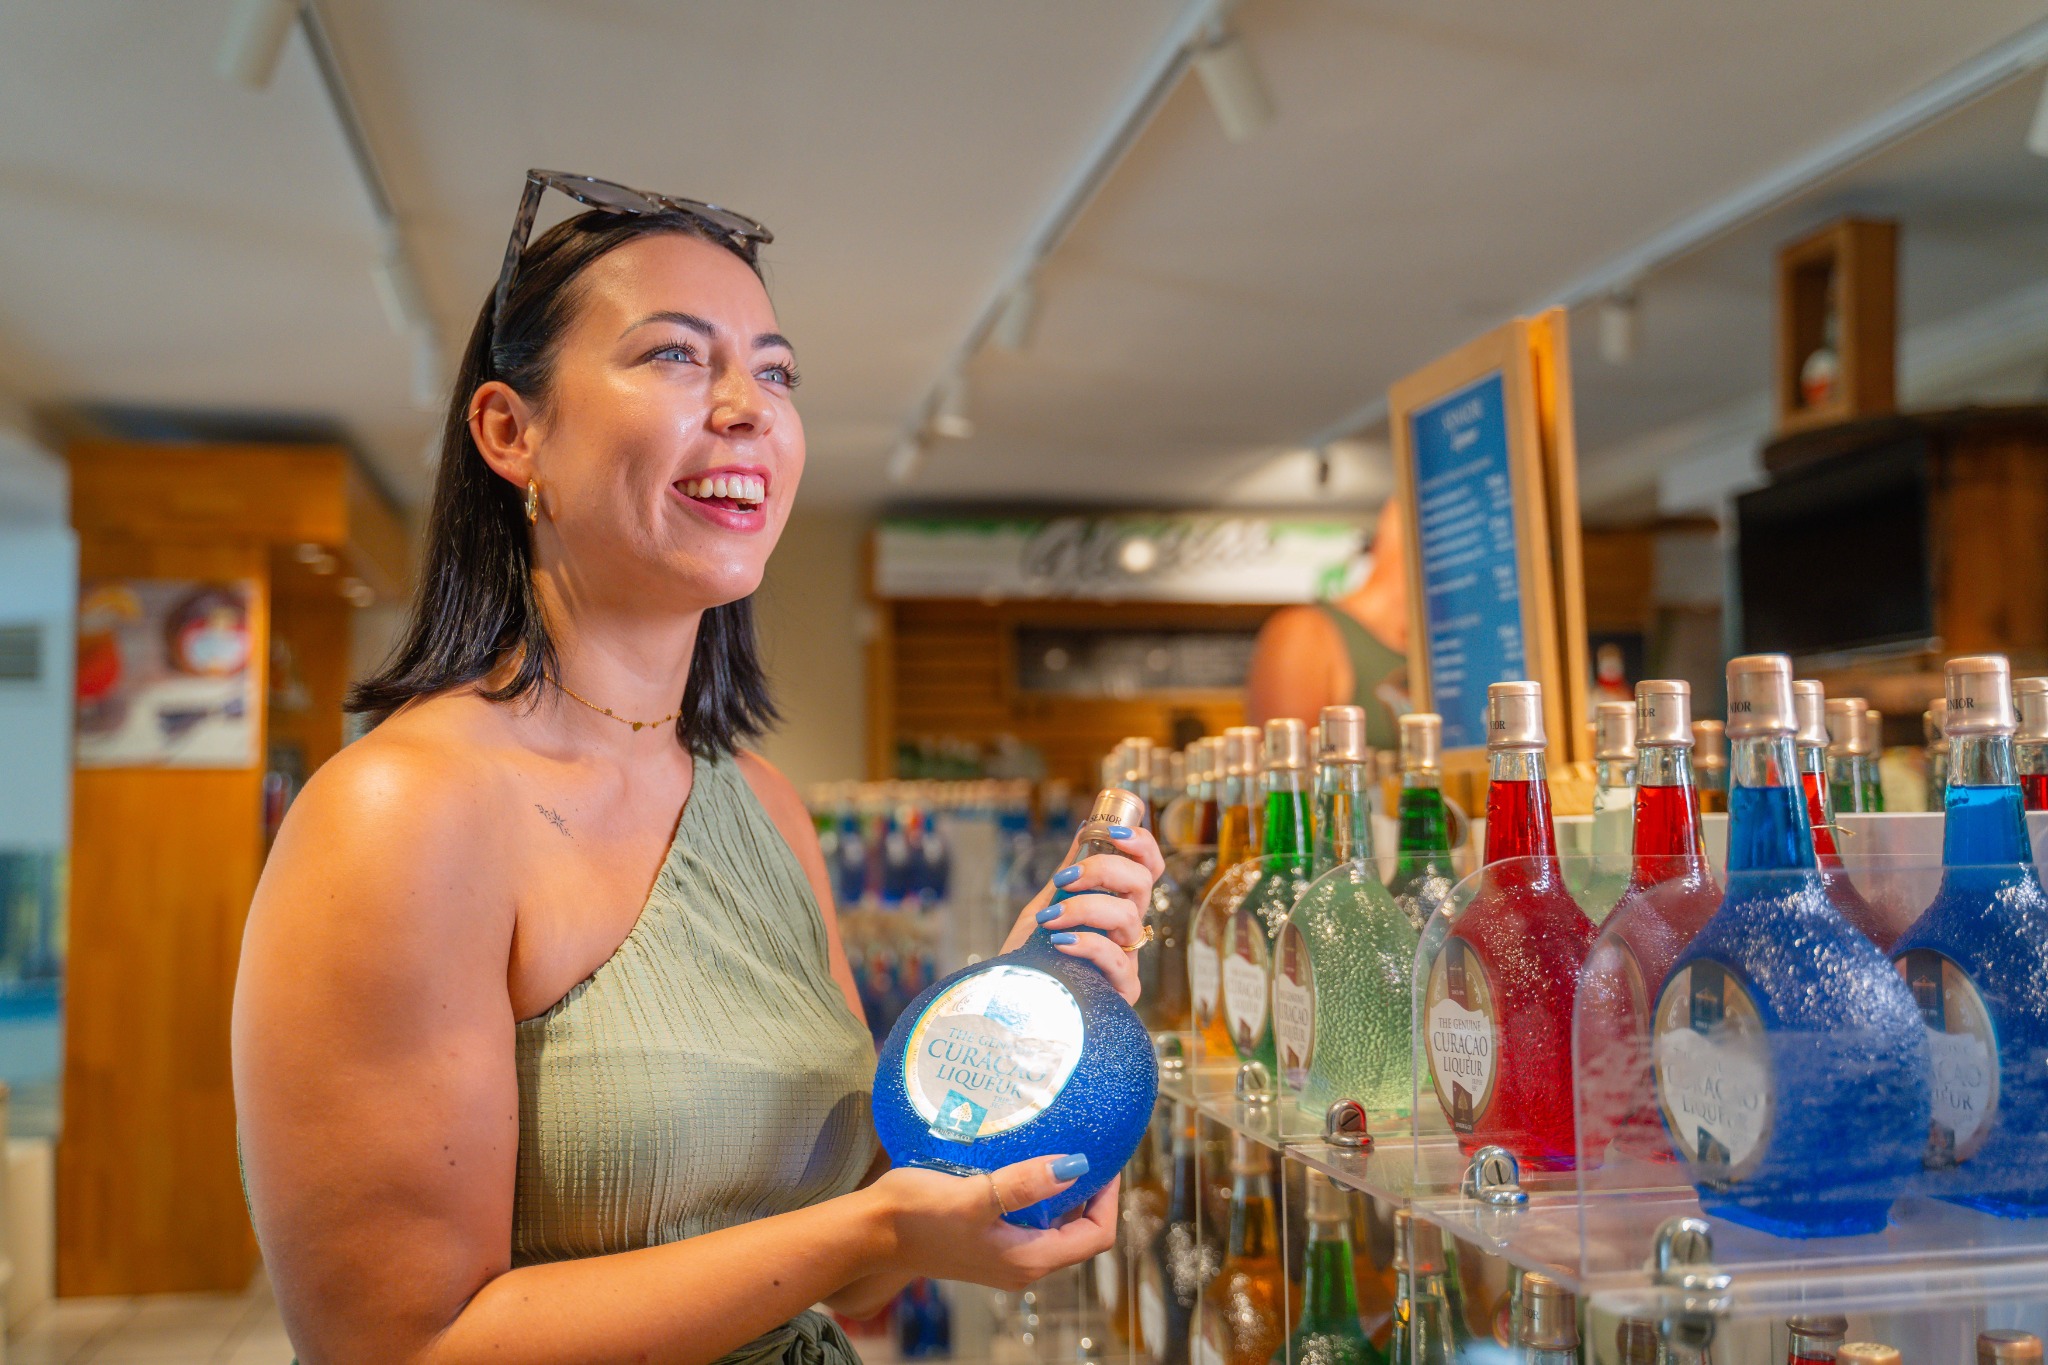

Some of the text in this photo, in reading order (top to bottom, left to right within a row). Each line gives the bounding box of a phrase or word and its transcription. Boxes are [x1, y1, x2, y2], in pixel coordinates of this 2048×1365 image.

[1090, 813, 1122, 825] SENIOR
[949, 1027, 976, 1043] THE
[1438, 1017, 1481, 1032] THE GENUINE
[1433, 1031, 1488, 1060] CURAÇAO
[927, 1038, 1047, 1083] CURAÇAO
[1443, 1056, 1484, 1078] LIQUEUR
[936, 1063, 1022, 1099] LIQUEUR
